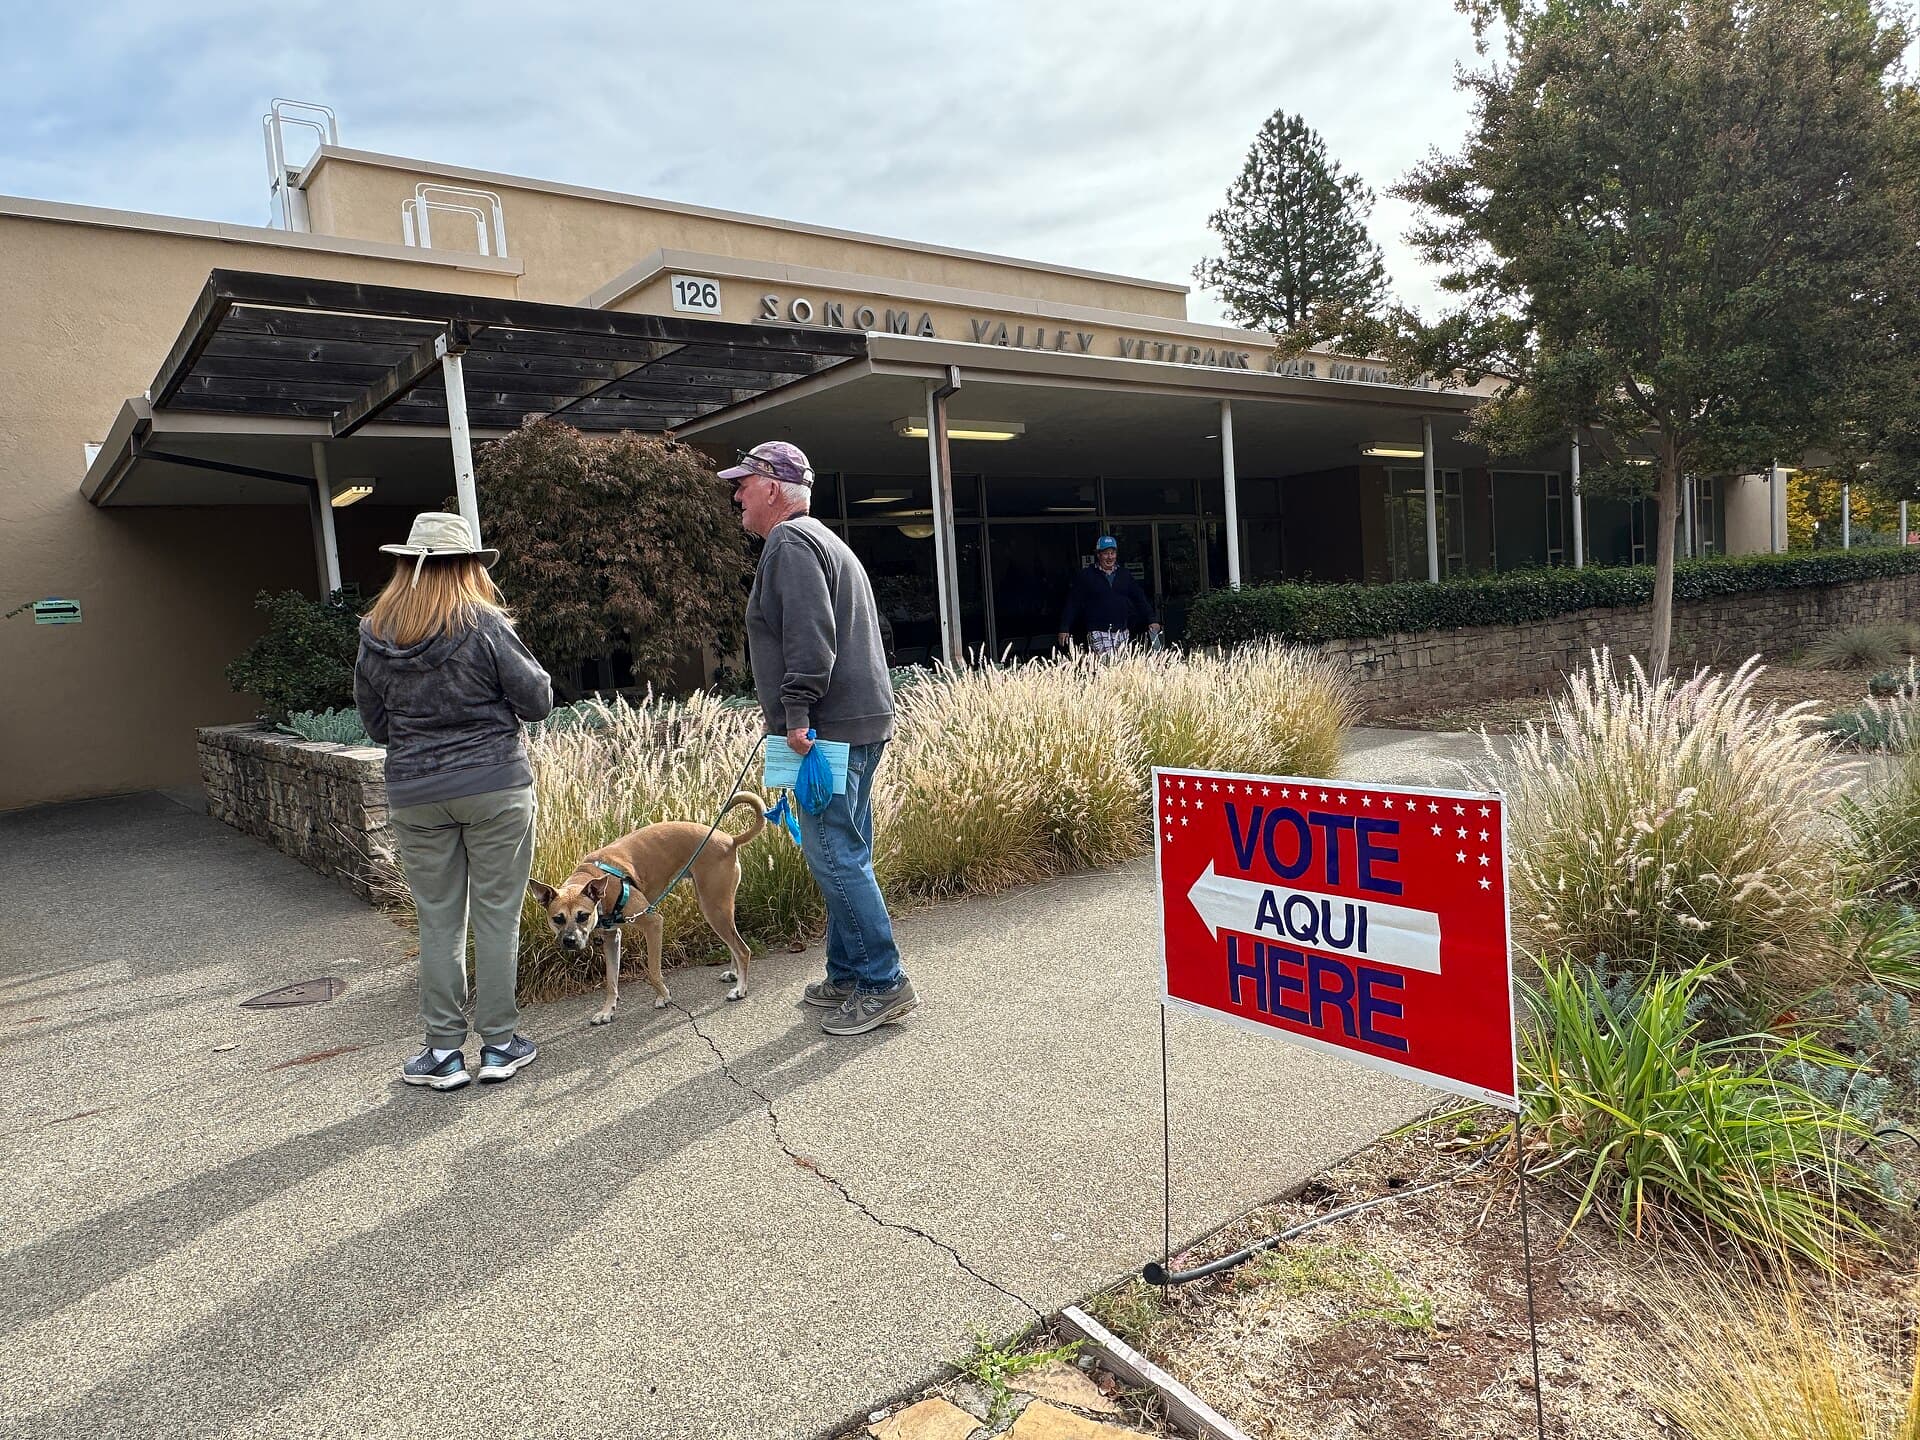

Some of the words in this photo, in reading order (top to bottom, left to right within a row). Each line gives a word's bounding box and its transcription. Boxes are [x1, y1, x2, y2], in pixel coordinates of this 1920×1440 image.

[675, 281, 718, 308] 126
[760, 294, 937, 338] SONOMA
[970, 319, 1094, 353] VALLEY
[1225, 802, 1403, 896] VOTE
[1254, 889, 1368, 954] AQUI
[1226, 935, 1410, 1053] HERE
